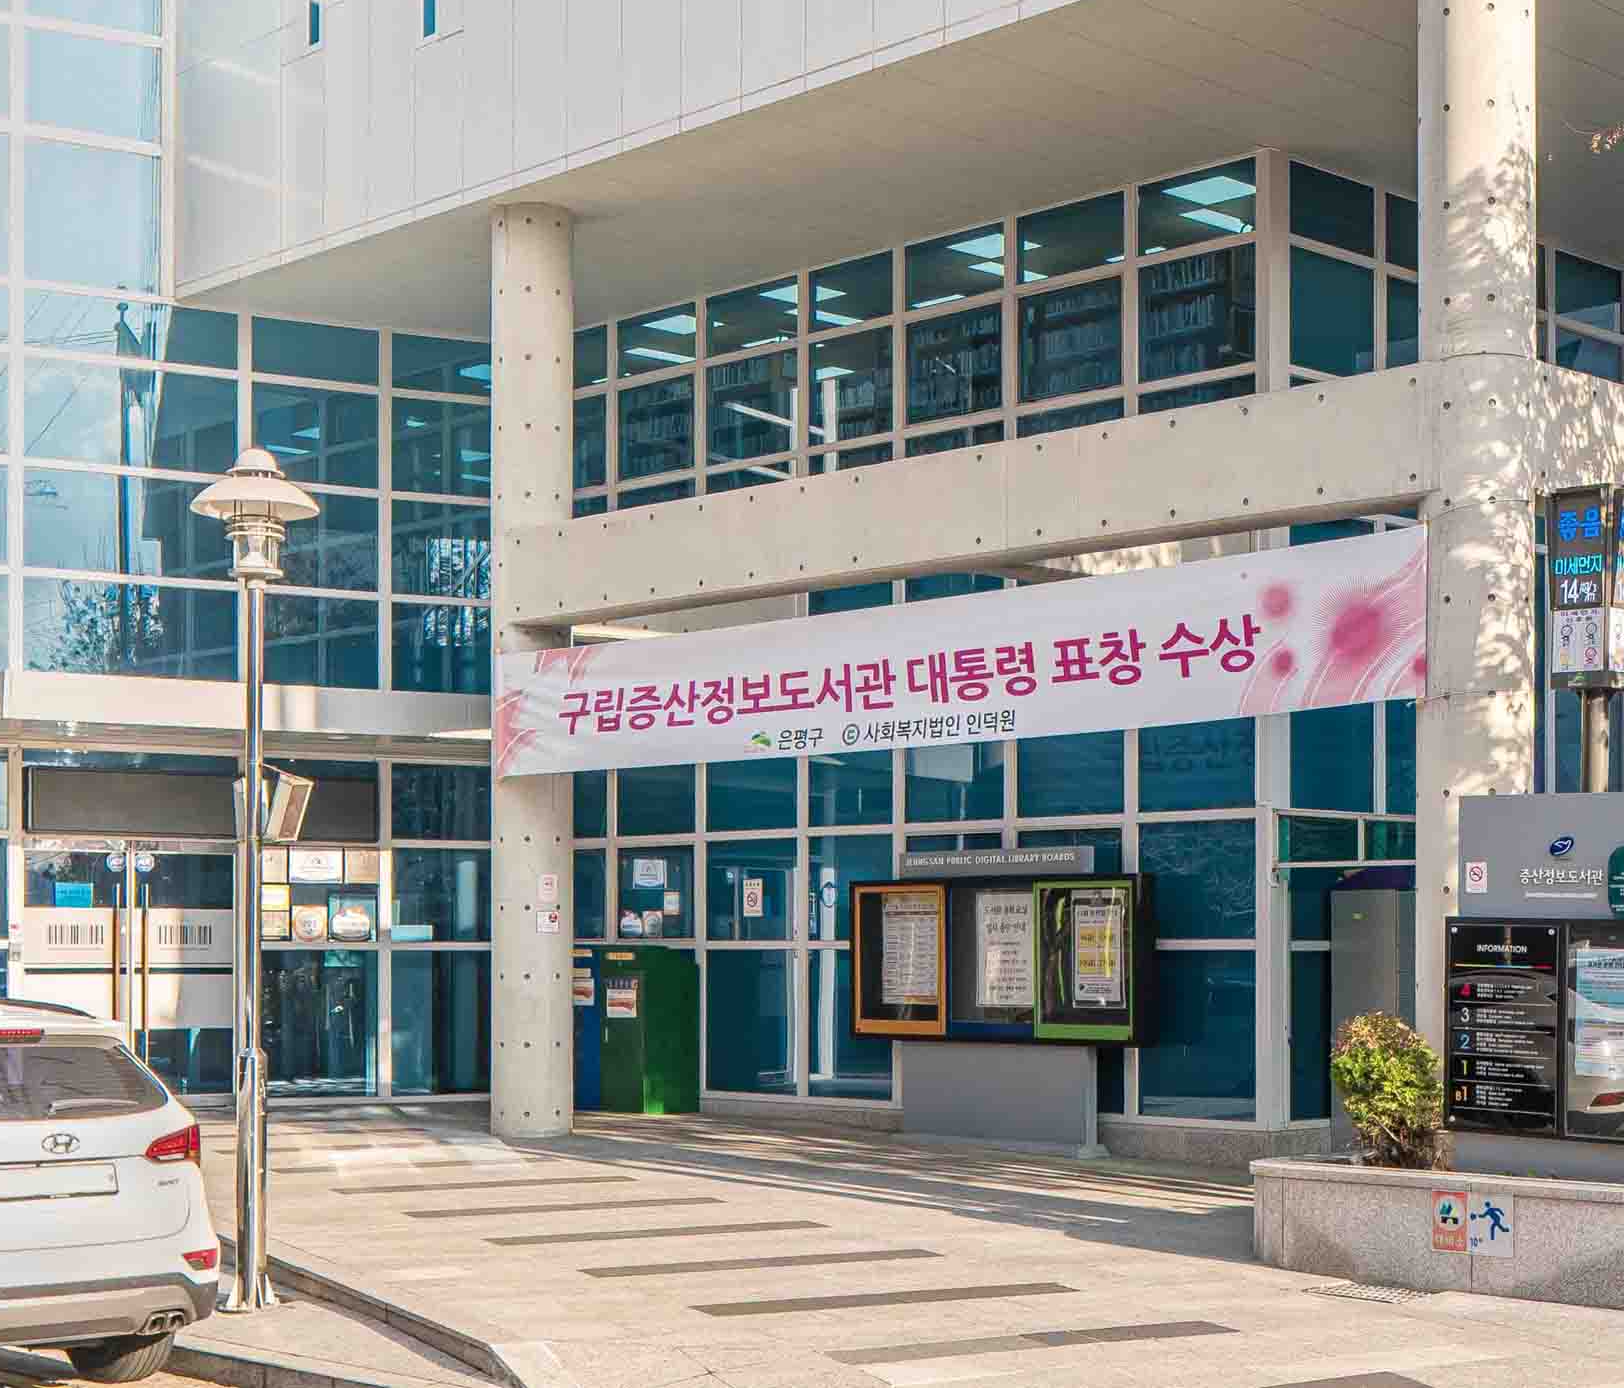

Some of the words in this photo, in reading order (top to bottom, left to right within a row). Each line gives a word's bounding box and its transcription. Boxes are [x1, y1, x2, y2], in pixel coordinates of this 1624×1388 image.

[1559, 507, 1601, 541] 좋음
[1554, 555, 1602, 575] 미세먼지
[1560, 578, 1579, 604] 14
[559, 658, 897, 735] 구립증산정보도서관
[906, 641, 1038, 704] 대통령
[1051, 628, 1146, 686] 표창
[1159, 613, 1261, 678] 수상
[862, 713, 962, 744] 사회복지법인
[966, 709, 1016, 735] 인덕원
[776, 727, 825, 751] 은평구
[946, 854, 973, 865] PUBLIC
[975, 853, 1007, 865] DIGITAL
[1008, 853, 1040, 864] LIBRARY
[1519, 868, 1604, 886] 증산정보도서관
[1476, 944, 1528, 953] INFORMATION
[1459, 982, 1471, 997] 4
[1460, 1007, 1471, 1023] 3
[1459, 1033, 1471, 1050] 2
[1461, 1059, 1468, 1076] 1
[1455, 1085, 1468, 1102] B1
